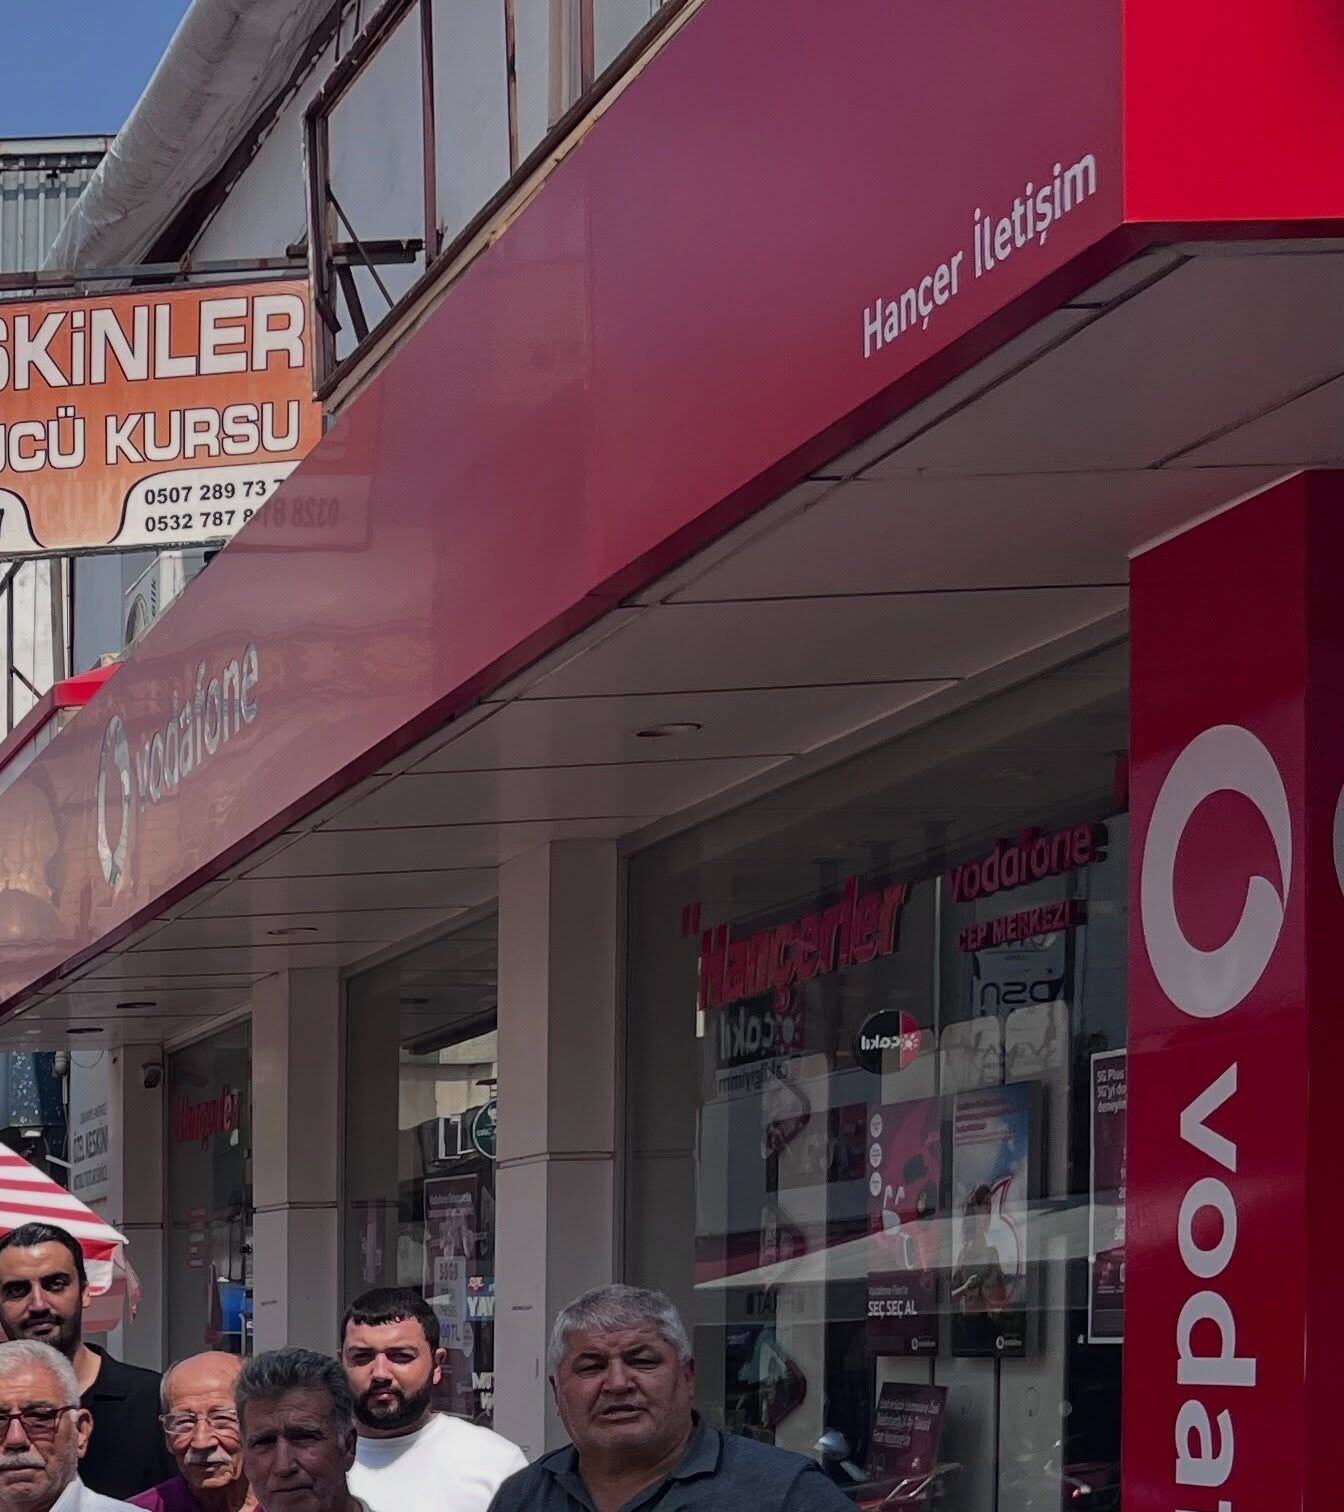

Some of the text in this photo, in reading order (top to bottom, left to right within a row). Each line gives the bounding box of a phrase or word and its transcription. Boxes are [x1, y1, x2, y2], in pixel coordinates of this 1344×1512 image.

[863, 151, 1097, 358] Hançer İletişim
[105, 401, 301, 466] KURSU
[144, 486, 193, 505] 0507
[199, 482, 236, 502] 289
[242, 479, 267, 497] 73
[144, 514, 194, 532] 0532
[199, 510, 236, 528] 787
[136, 641, 259, 814] vodafone
[945, 821, 1095, 903] vodafone
[868, 1299, 918, 1319] SEÇ SEÇ AL
